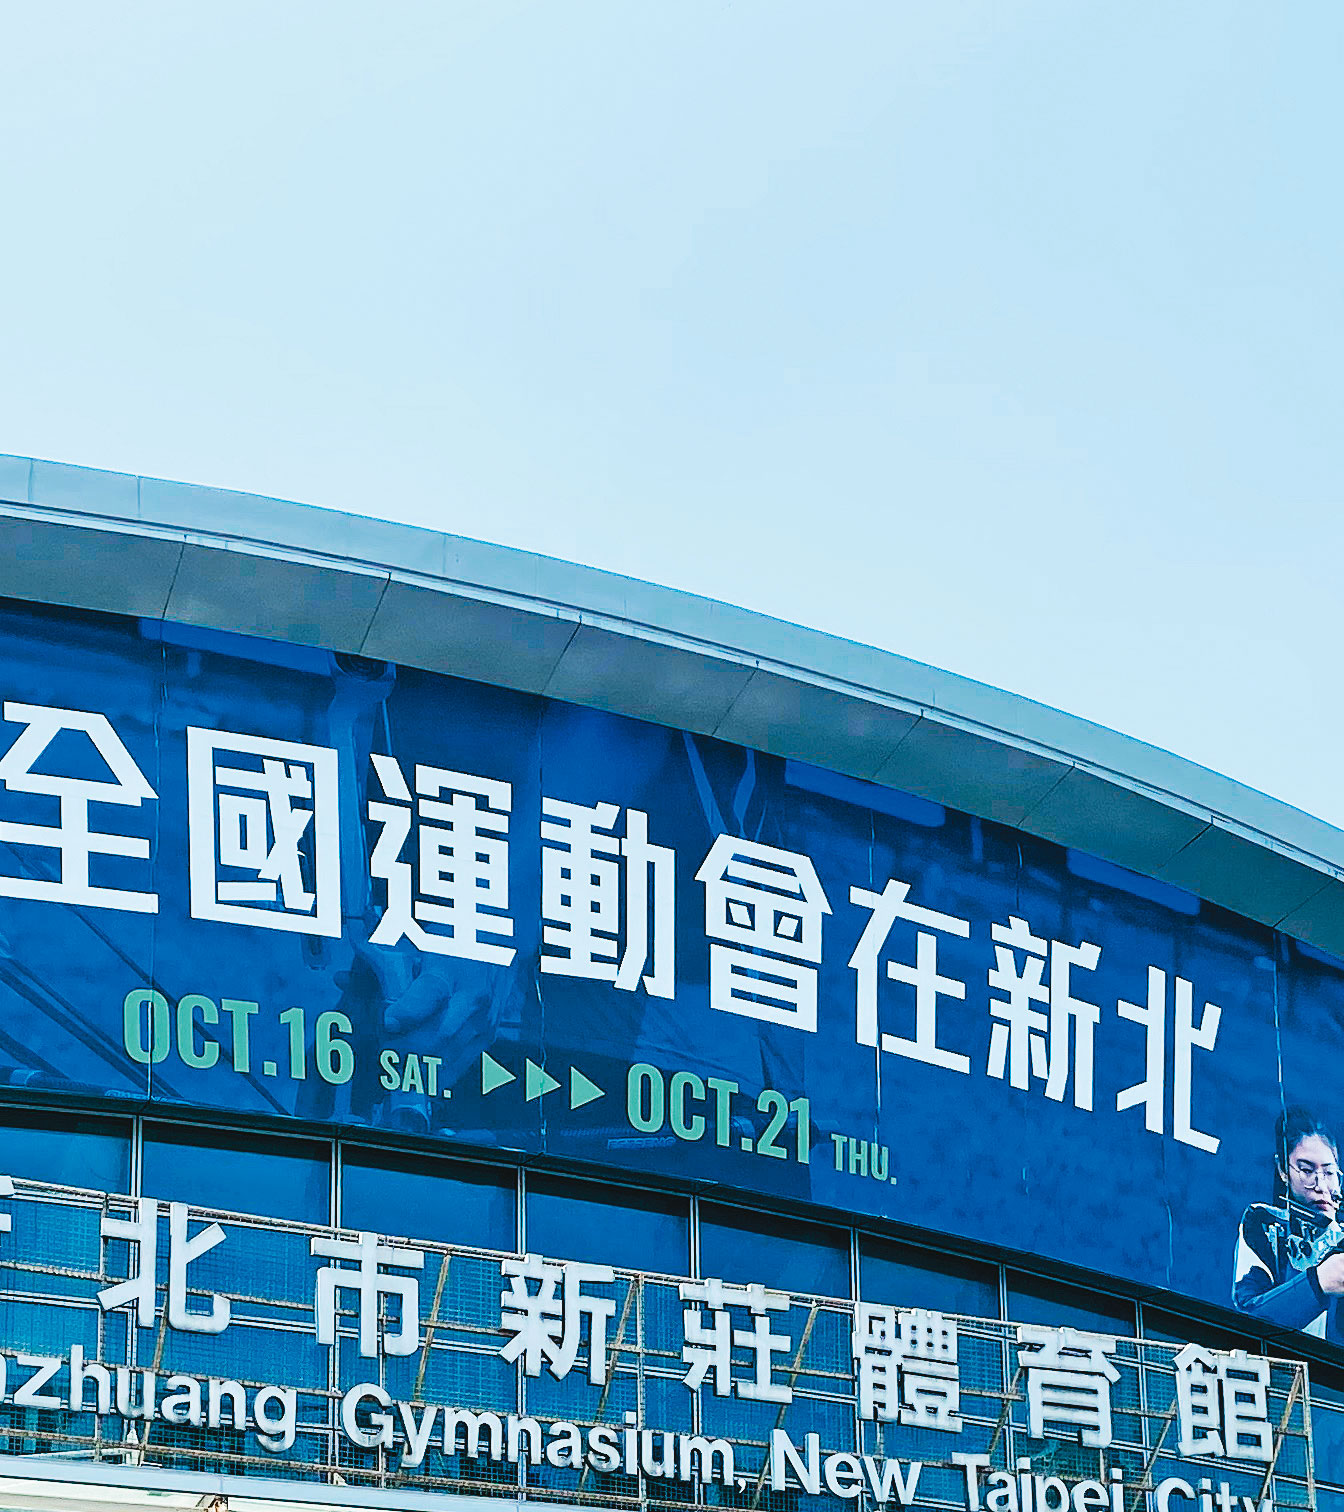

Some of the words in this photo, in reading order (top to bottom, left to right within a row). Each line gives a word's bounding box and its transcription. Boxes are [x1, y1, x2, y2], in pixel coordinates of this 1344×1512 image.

[123, 988, 355, 1086] OCT.16
[378, 1049, 452, 1099] SAT.
[626, 1062, 812, 1166] OCT.21
[830, 1132, 898, 1186] THU.
[340, 1381, 748, 1494] Gymnasium,
[770, 1427, 923, 1506] New
